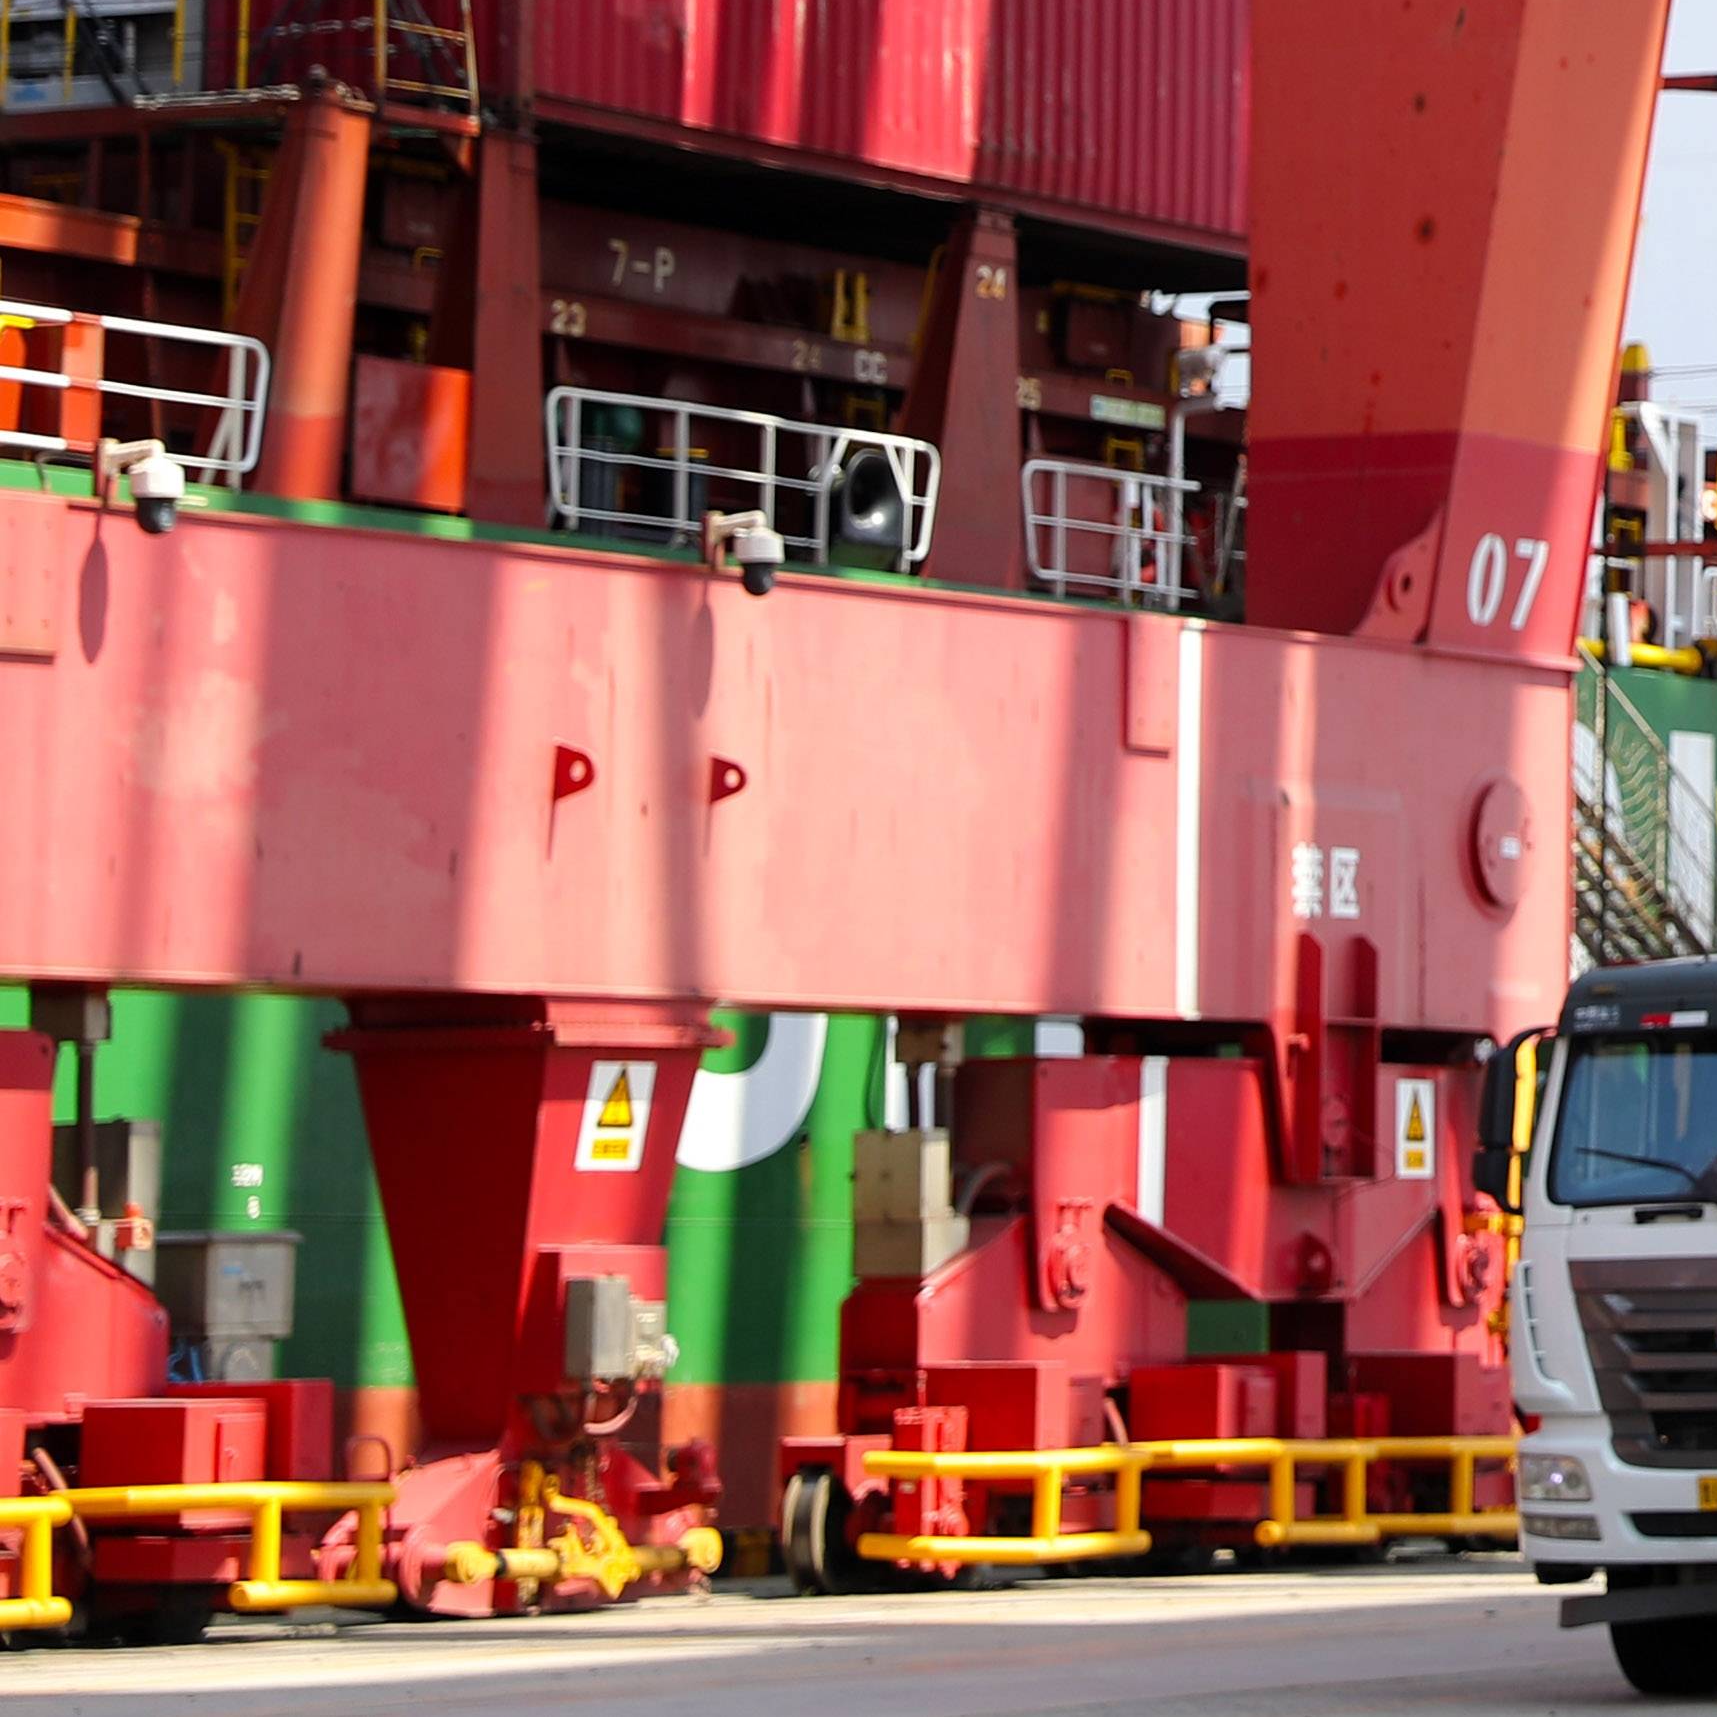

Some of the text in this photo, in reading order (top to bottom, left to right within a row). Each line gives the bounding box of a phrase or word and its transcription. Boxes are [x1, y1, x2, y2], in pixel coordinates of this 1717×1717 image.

[607, 237, 676, 295] 7-P
[549, 298, 588, 338] 23
[1465, 532, 1549, 633] 07
